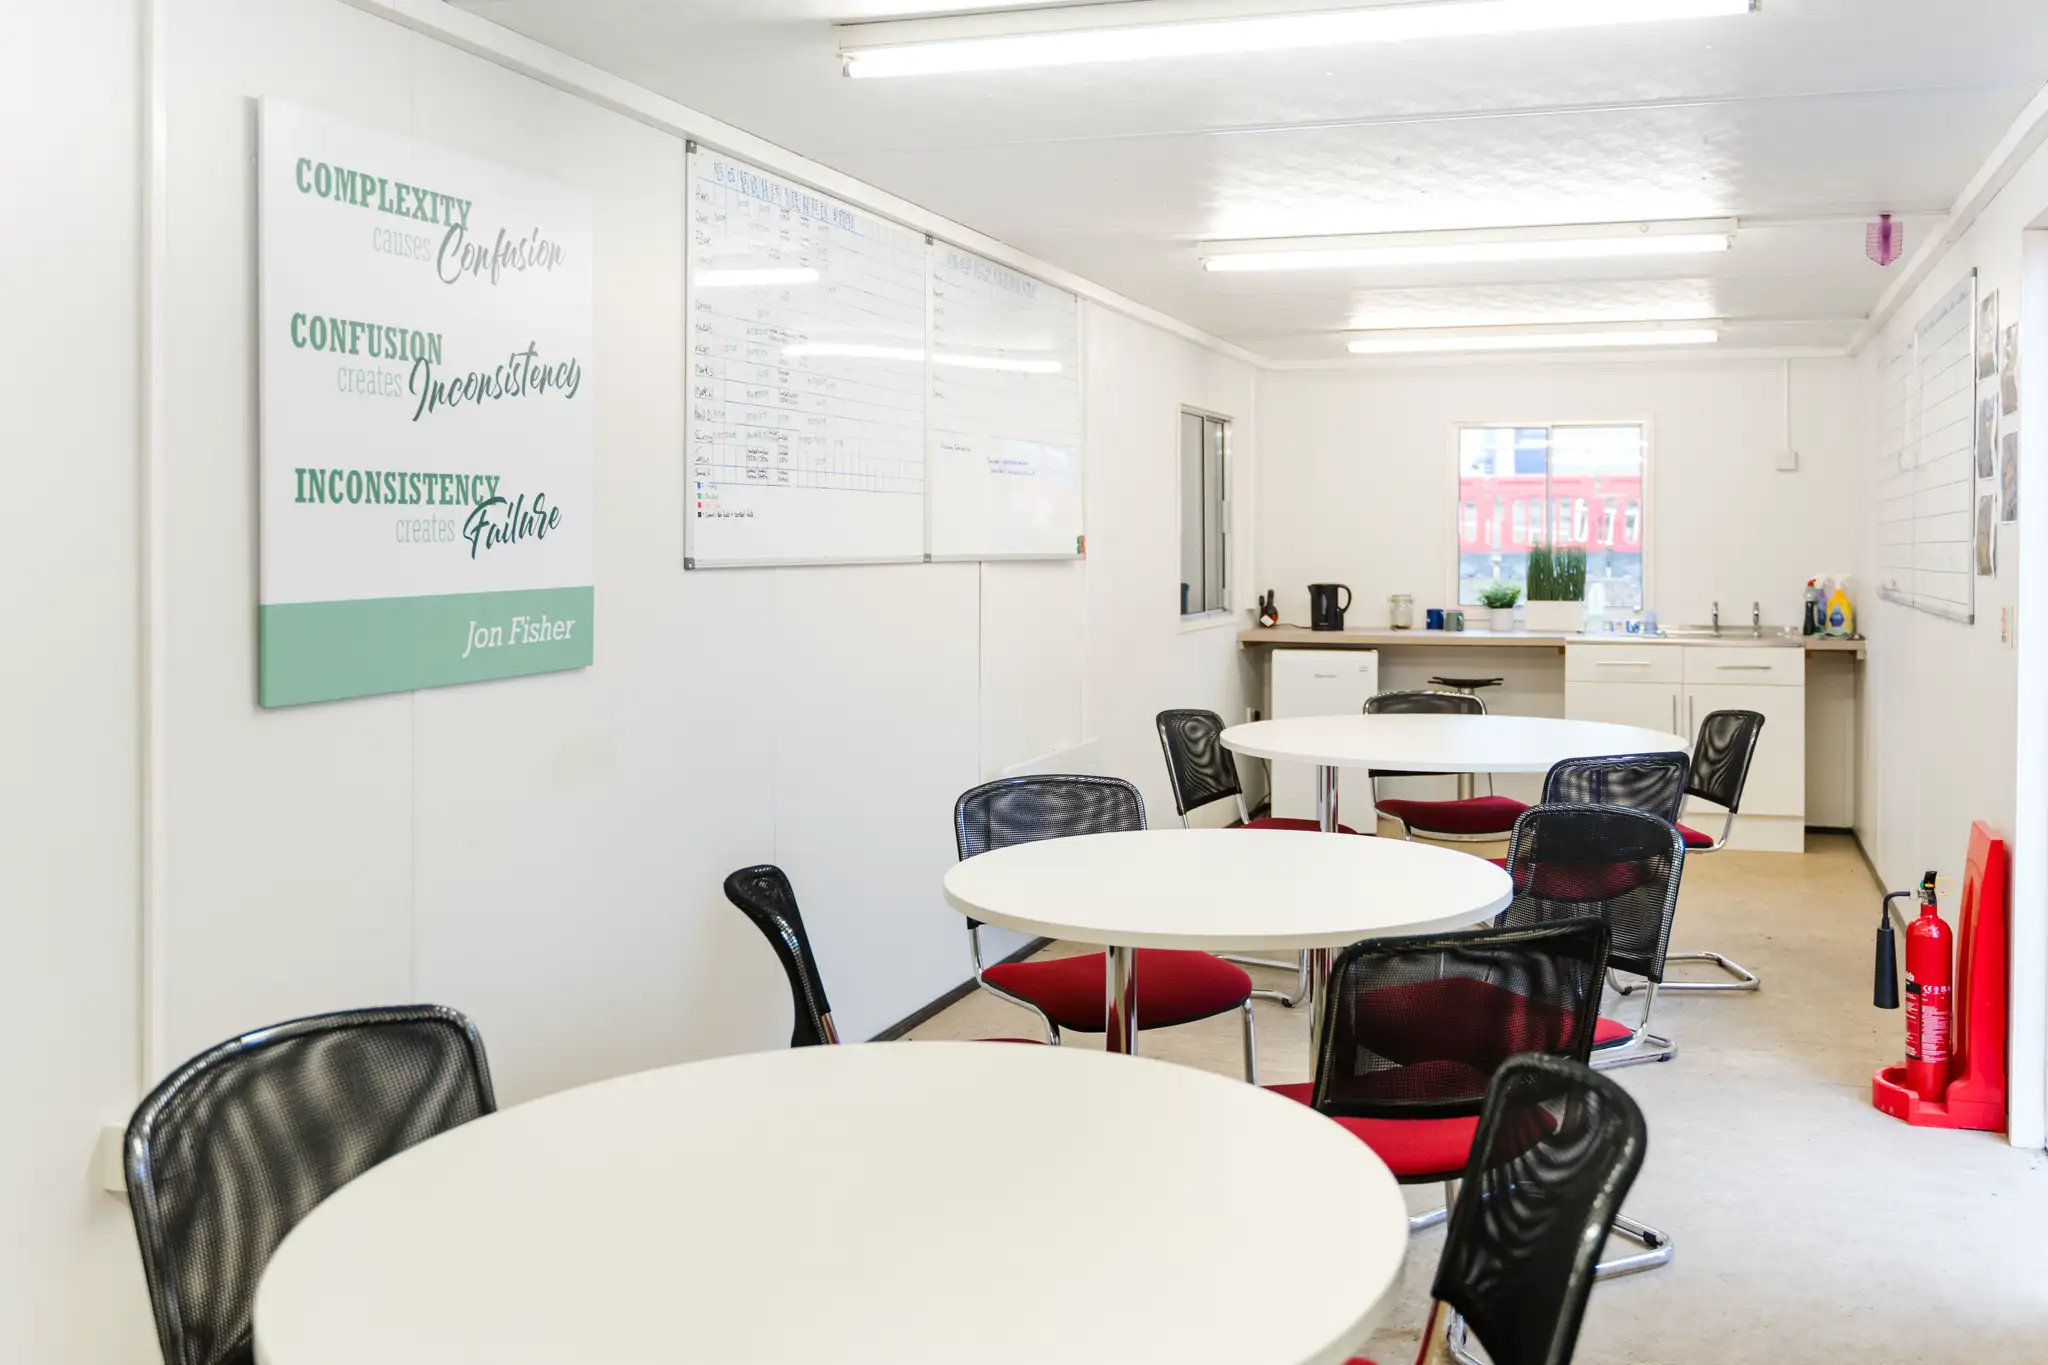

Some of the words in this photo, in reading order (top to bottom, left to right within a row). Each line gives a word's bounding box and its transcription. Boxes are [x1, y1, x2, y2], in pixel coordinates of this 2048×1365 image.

[295, 157, 472, 231] COMPLEXITY
[373, 226, 431, 262] causes
[437, 222, 567, 286] Confusion
[290, 312, 443, 366] CONFUSION
[337, 365, 402, 398] creates
[408, 340, 582, 422] Inconsistency
[294, 467, 501, 506] INCONSISTENCY
[396, 513, 456, 544] creates
[463, 492, 562, 560] Failure
[462, 620, 503, 658] Jon
[508, 614, 576, 646] Fisher
